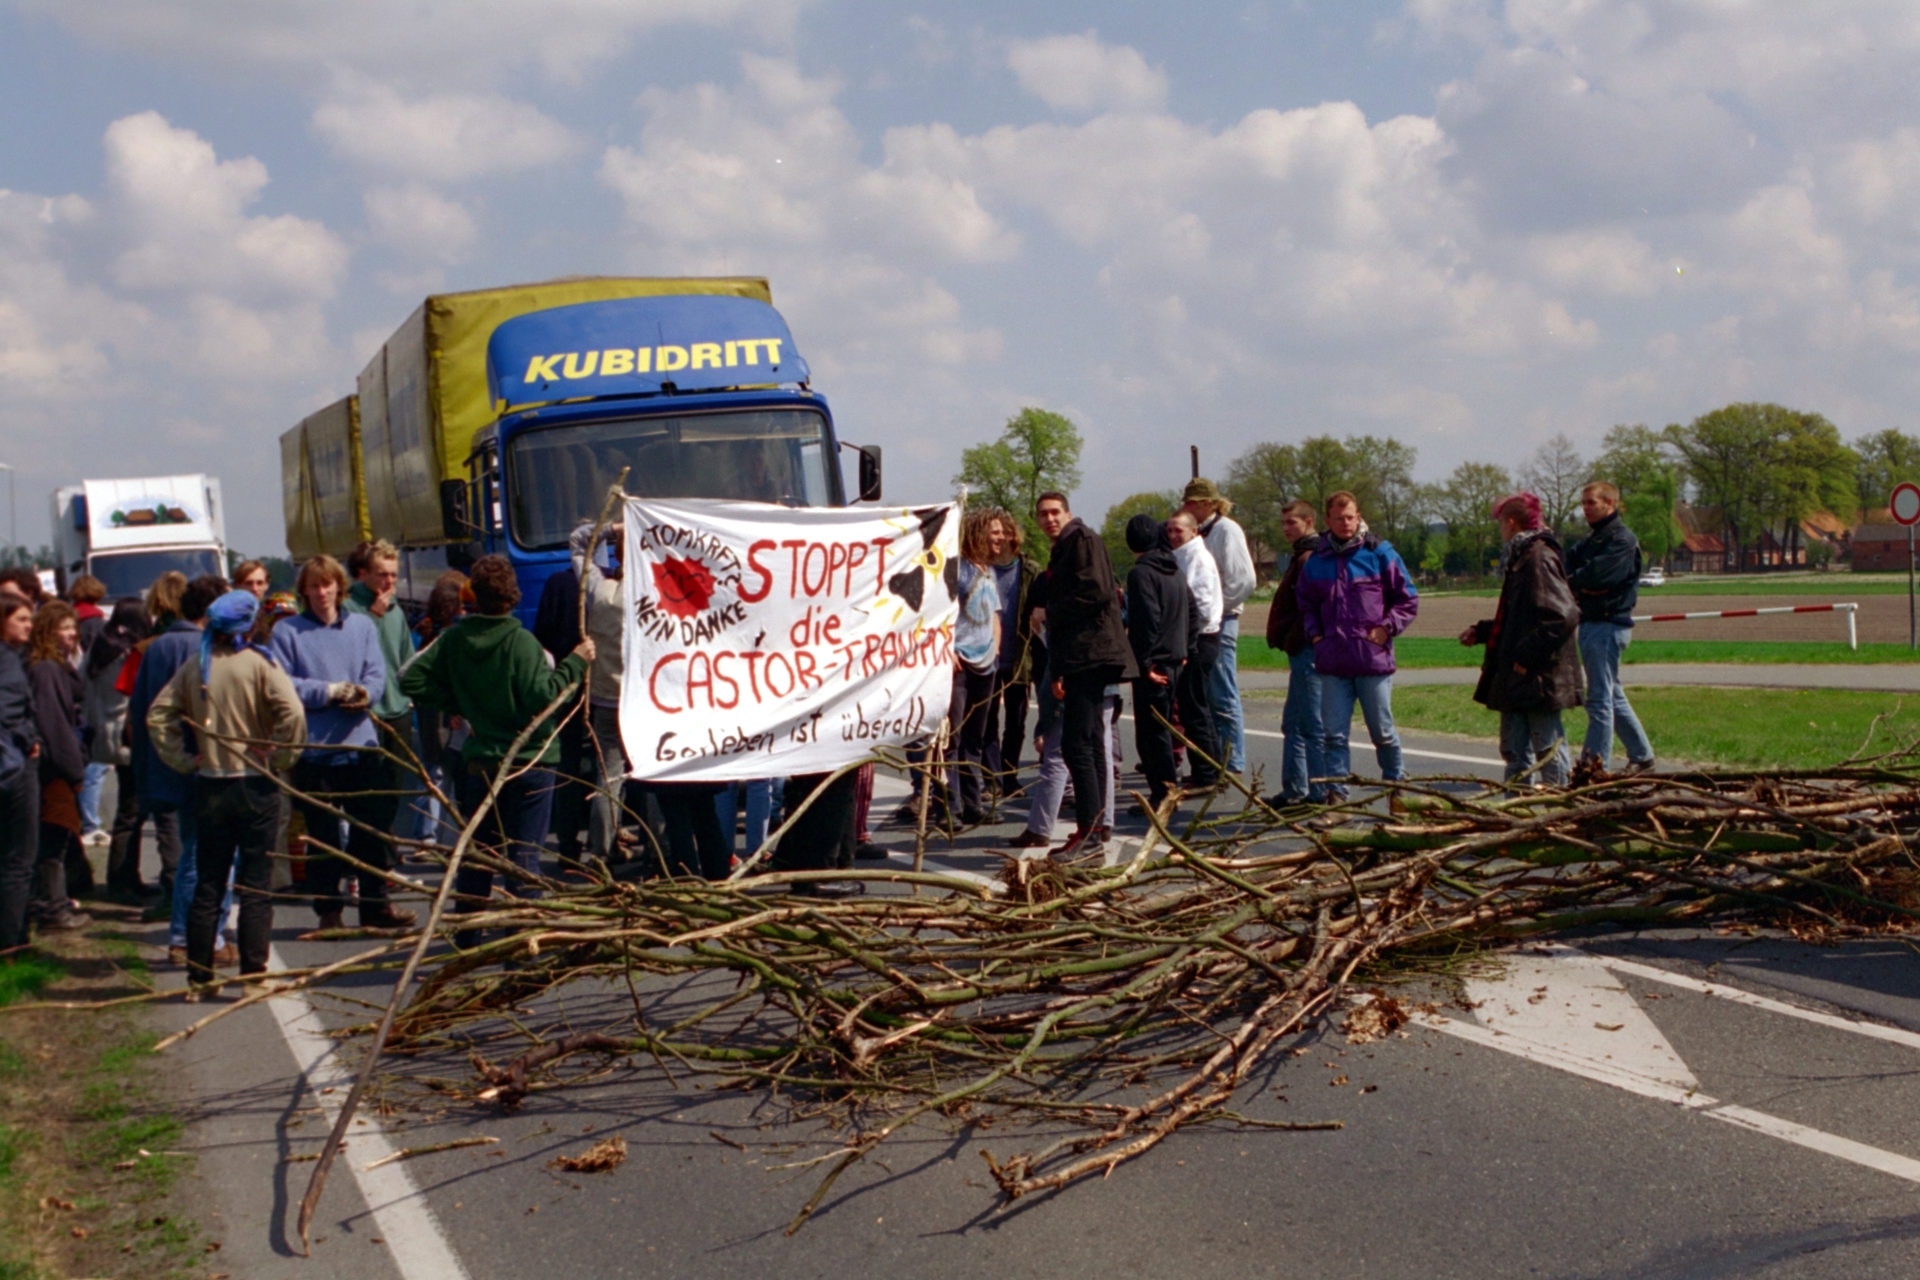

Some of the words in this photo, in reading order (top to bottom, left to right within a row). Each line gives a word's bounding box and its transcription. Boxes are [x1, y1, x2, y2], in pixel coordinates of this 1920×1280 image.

[524, 339, 782, 383] KUBIDRITT
[737, 538, 895, 603] STOPPT
[680, 600, 747, 646] DANKE
[790, 606, 842, 648] die
[790, 706, 823, 743] ist
[842, 696, 926, 742] überall
